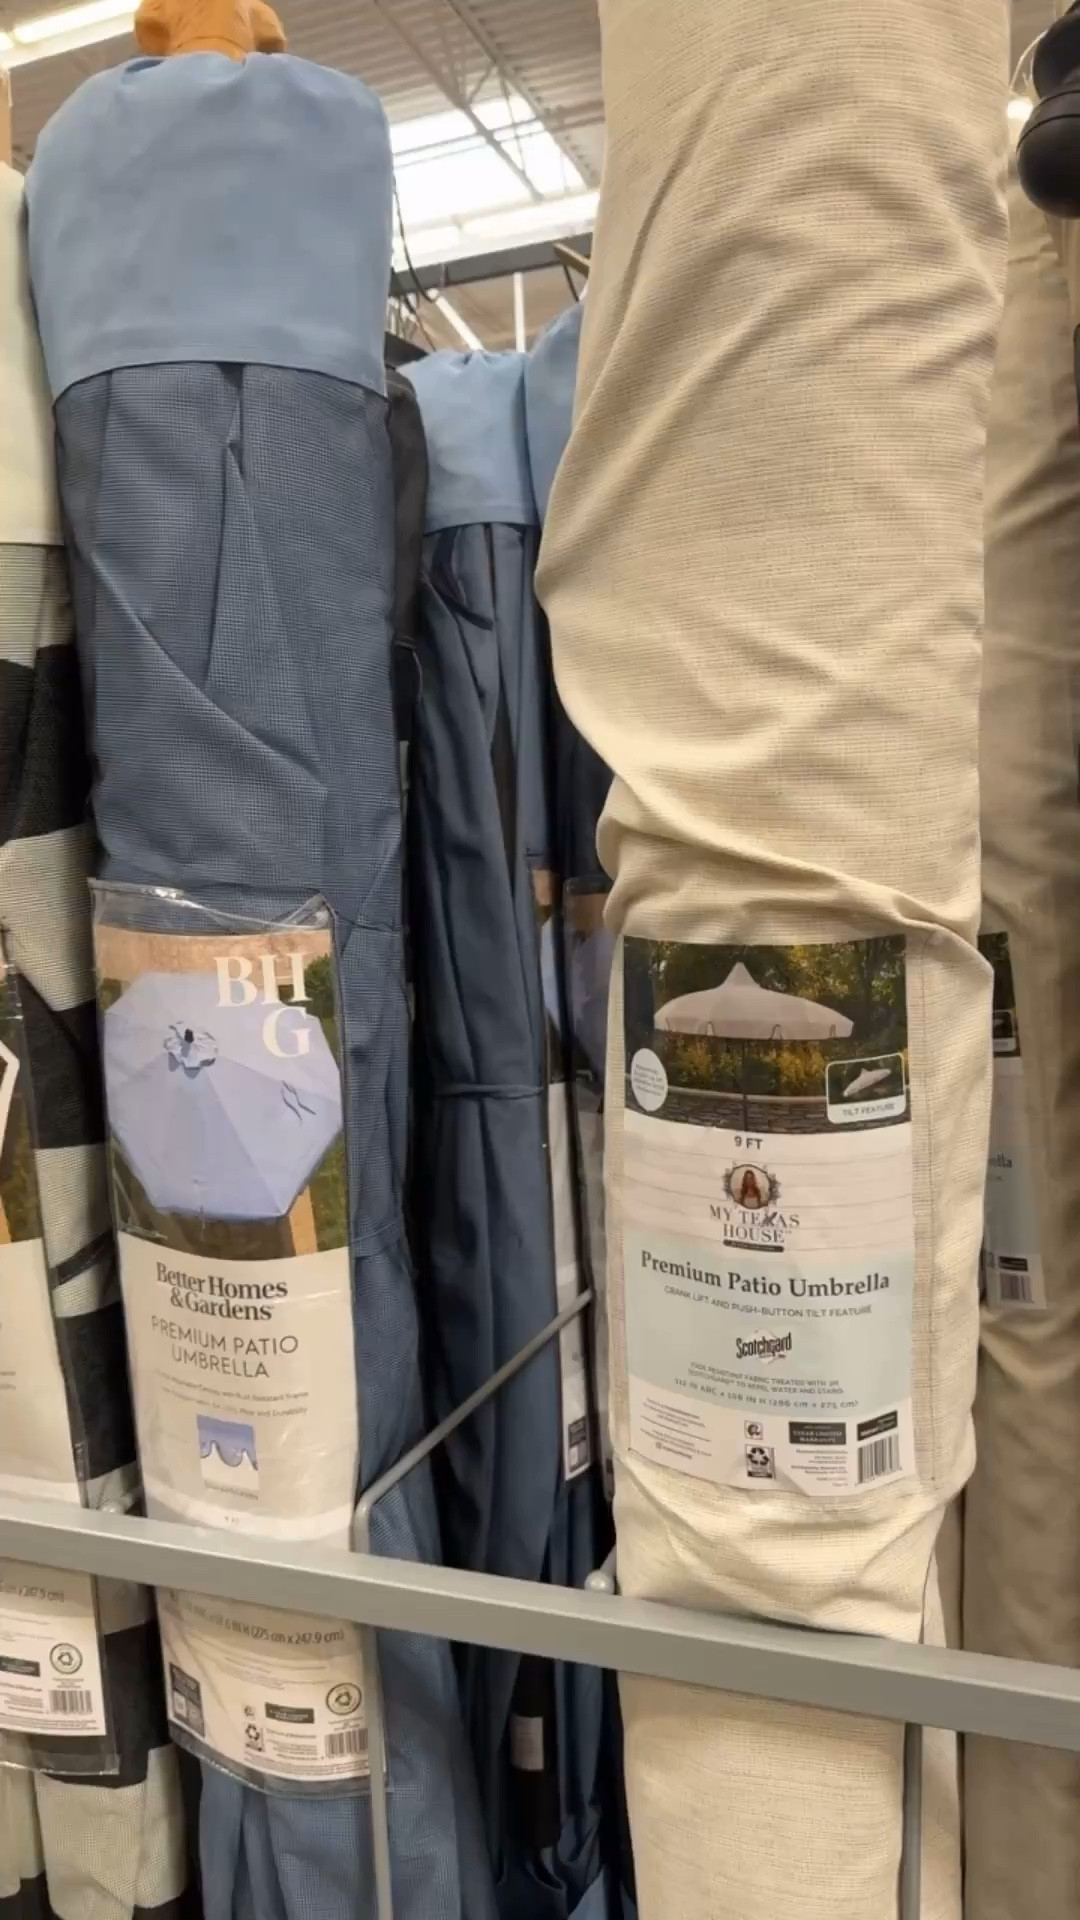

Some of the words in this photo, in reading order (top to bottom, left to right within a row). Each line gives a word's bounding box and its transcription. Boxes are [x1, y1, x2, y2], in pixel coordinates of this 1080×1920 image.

[214, 952, 313, 1008] BH
[262, 1005, 312, 1059] G
[734, 1135, 743, 1148] 9
[746, 1137, 763, 1151] FT
[709, 1204, 732, 1221] MY
[738, 1210, 800, 1228] TEXAS
[156, 1261, 205, 1293] Better
[208, 1275, 288, 1300] Homes
[641, 1251, 722, 1288] Premium
[728, 1272, 782, 1297] Patio
[789, 1272, 890, 1298] Umbrella
[664, 1284, 692, 1299] CRANK
[692, 1292, 709, 1304] LIFT
[711, 1298, 730, 1309] AND
[806, 1308, 827, 1318] TILT
[829, 1304, 873, 1317] FEATURE
[151, 1315, 226, 1352] PREMIUM
[233, 1335, 299, 1357] PATIO
[736, 1331, 792, 1359] Scotchgard
[171, 1346, 270, 1378] UMBRELLA
[771, 1385, 798, 1394] WATER
[270, 1632, 286, 1643] cm
